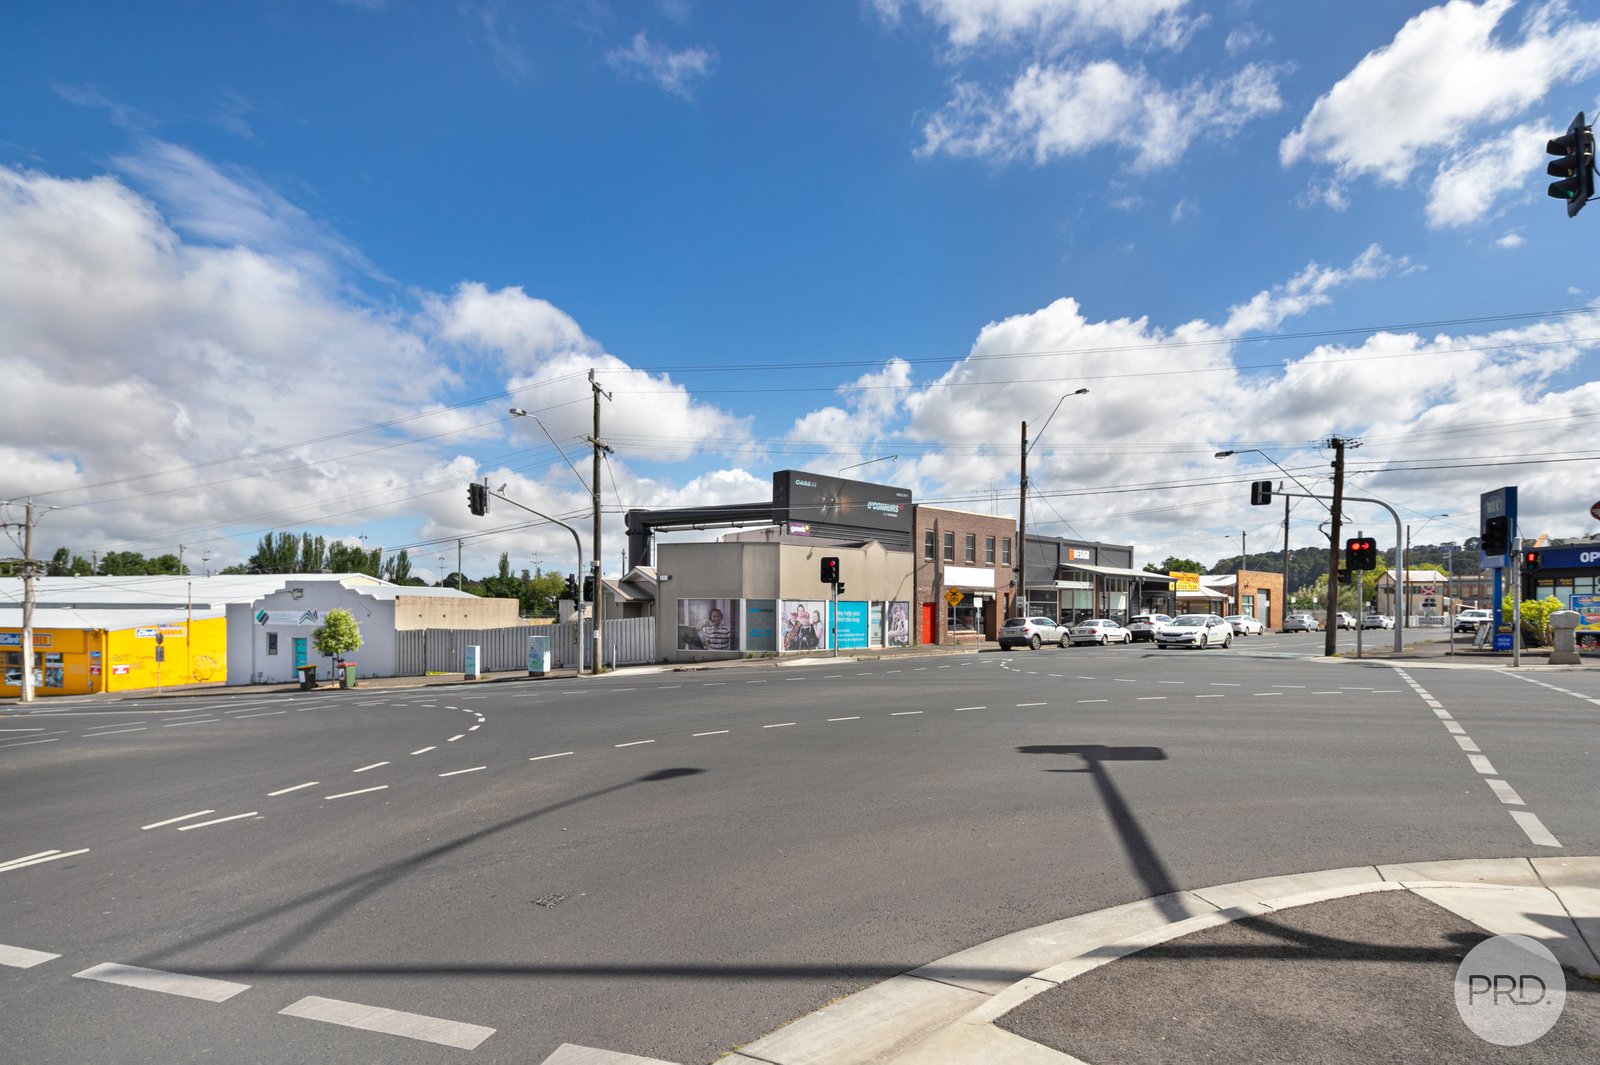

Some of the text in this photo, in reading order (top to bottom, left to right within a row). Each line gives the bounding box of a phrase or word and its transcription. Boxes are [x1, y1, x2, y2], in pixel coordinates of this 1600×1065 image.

[795, 479, 811, 487] CASE
[867, 501, 899, 513] O'CONNORS
[790, 525, 806, 533] gawk
[1579, 551, 1600, 563] OP
